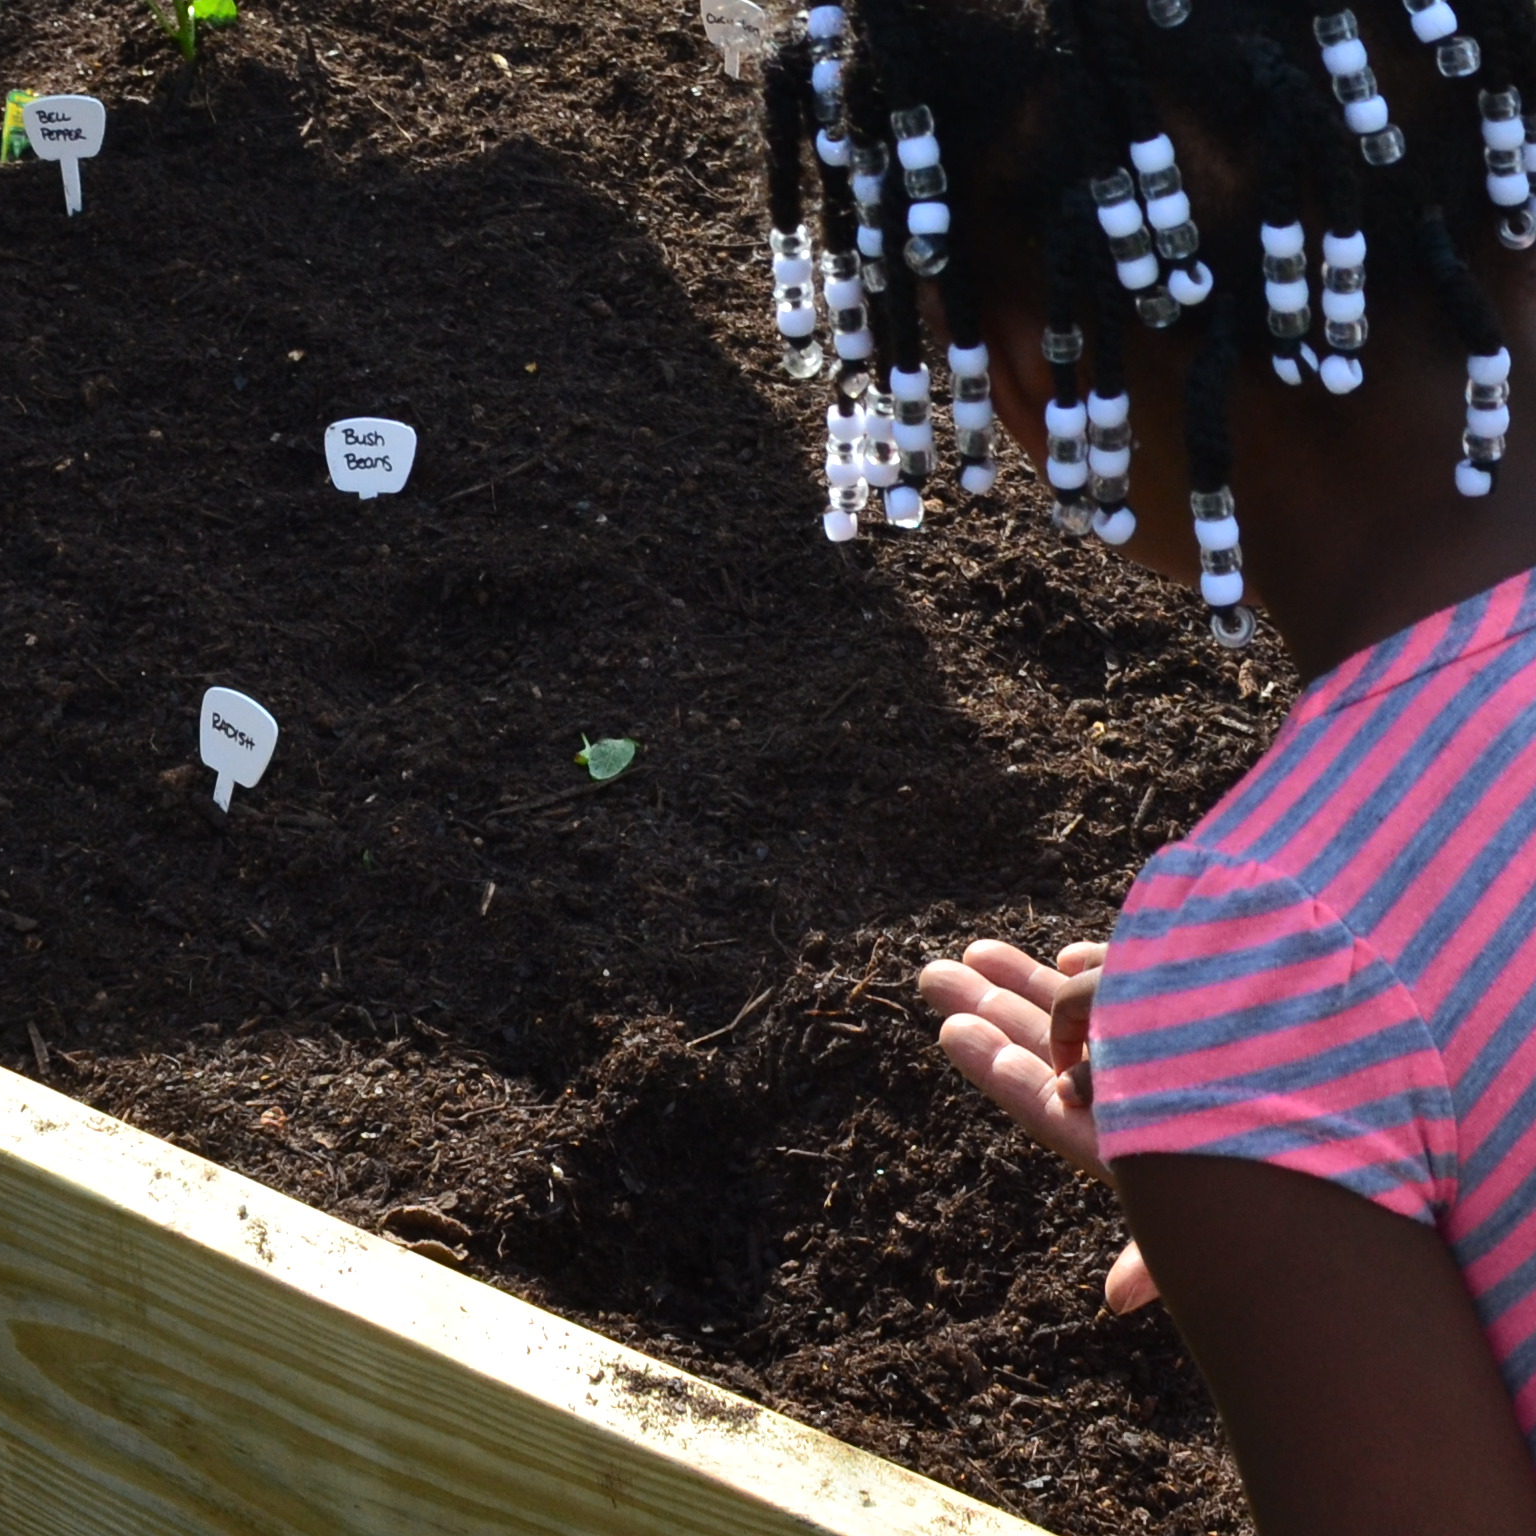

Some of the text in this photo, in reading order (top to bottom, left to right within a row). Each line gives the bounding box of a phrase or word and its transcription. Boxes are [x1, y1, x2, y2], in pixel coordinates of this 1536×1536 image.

[35, 110, 72, 124] BELL
[40, 127, 87, 142] PEPPER
[342, 428, 385, 446] Bush
[211, 712, 256, 752] RADISH
